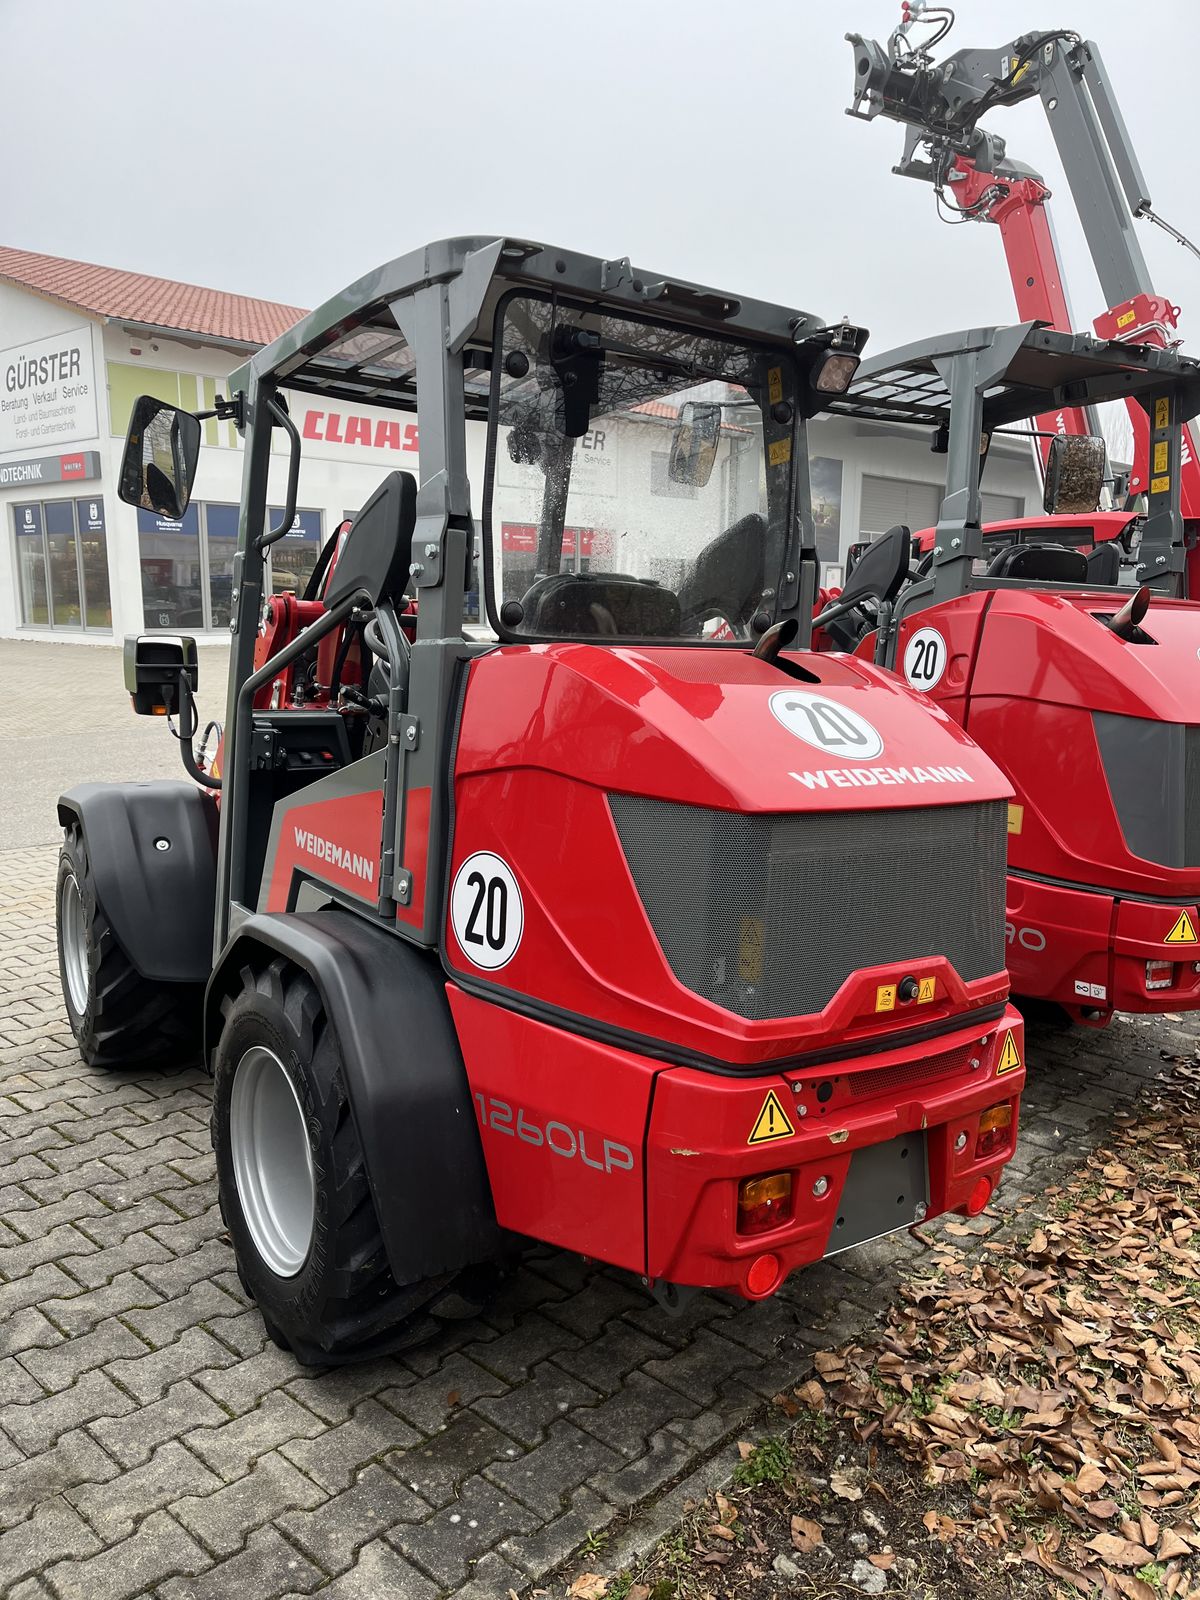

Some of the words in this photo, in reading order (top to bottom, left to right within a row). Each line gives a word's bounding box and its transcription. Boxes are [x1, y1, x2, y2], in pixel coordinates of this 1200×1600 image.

[6, 348, 81, 393] GÜRSTER
[1, 398, 29, 412] Beratung
[33, 388, 57, 405] Verkauf
[62, 384, 88, 399] Service
[28, 411, 38, 422] und
[39, 404, 76, 420] Baumaschinen
[30, 426, 40, 437] und
[41, 419, 76, 434] Gartentechnik
[302, 410, 420, 452] CLAAS
[911, 639, 938, 680] 20
[784, 702, 867, 745] 20
[787, 766, 975, 789] WEIDEMANN
[294, 826, 374, 883] WEIDEMANN
[464, 871, 508, 950] 20
[475, 1093, 634, 1174] 1260LP
